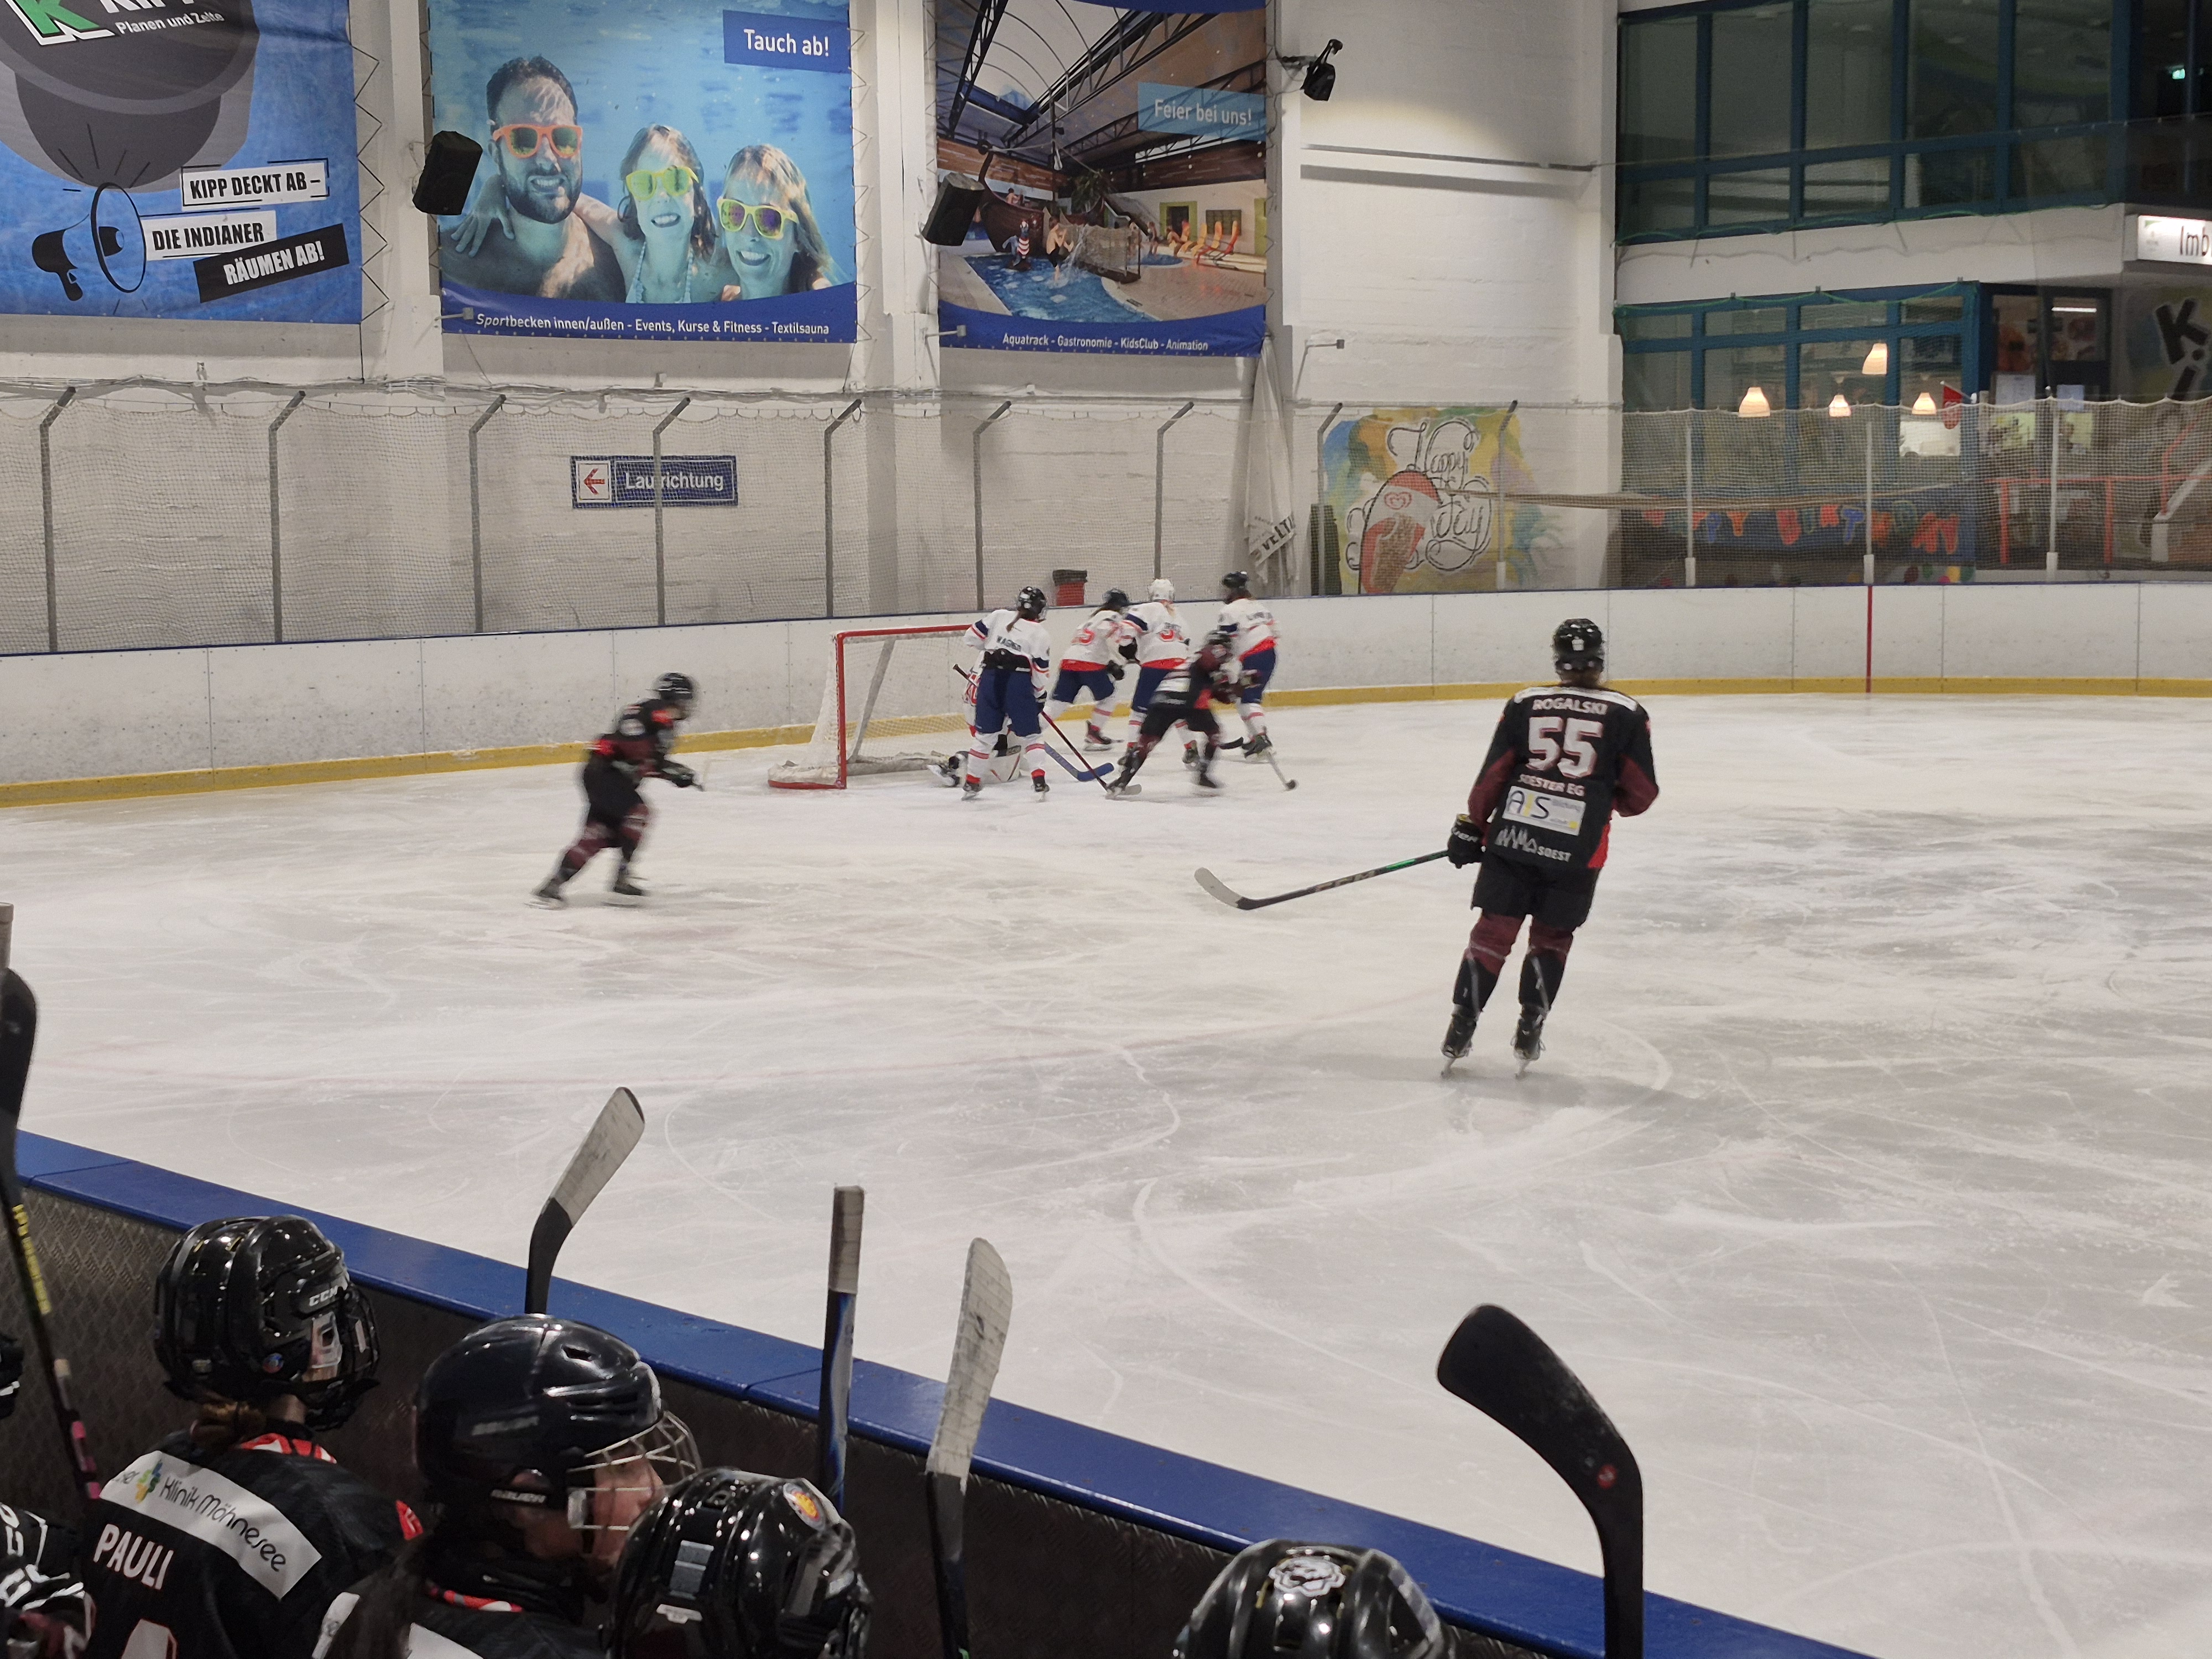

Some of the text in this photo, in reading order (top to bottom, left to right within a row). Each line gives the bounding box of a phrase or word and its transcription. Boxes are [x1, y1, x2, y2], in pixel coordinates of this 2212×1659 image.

[115, 11, 225, 34] Planen und Zelte
[743, 28, 829, 57] Tauch ab!
[1155, 99, 1251, 126] Feier bei uns!
[190, 178, 228, 200] KIPP
[231, 173, 281, 196] DECKT
[286, 171, 307, 191] AB
[152, 222, 265, 251] DIE INDIANER
[223, 241, 325, 285] RÄUMEN AB!
[476, 313, 551, 328] Sportbecken
[554, 316, 624, 331] innen/außen
[635, 319, 675, 334] Events,
[678, 319, 709, 332] Kurse
[712, 320, 721, 333] &
[723, 320, 762, 333] Fitness
[771, 321, 830, 335] Textilsauna
[1003, 332, 1048, 346] Aquatrack
[1057, 335, 1112, 348] Gastronomie
[1120, 337, 1159, 349] KidsClub
[1166, 339, 1208, 351] Animation
[625, 471, 724, 492] Laurichtung
[1525, 716, 1604, 779] 55
[1537, 846, 1572, 863] SOEST
[159, 1477, 286, 1573] Klinik Möhnesee
[93, 1524, 174, 1590] PAULI
